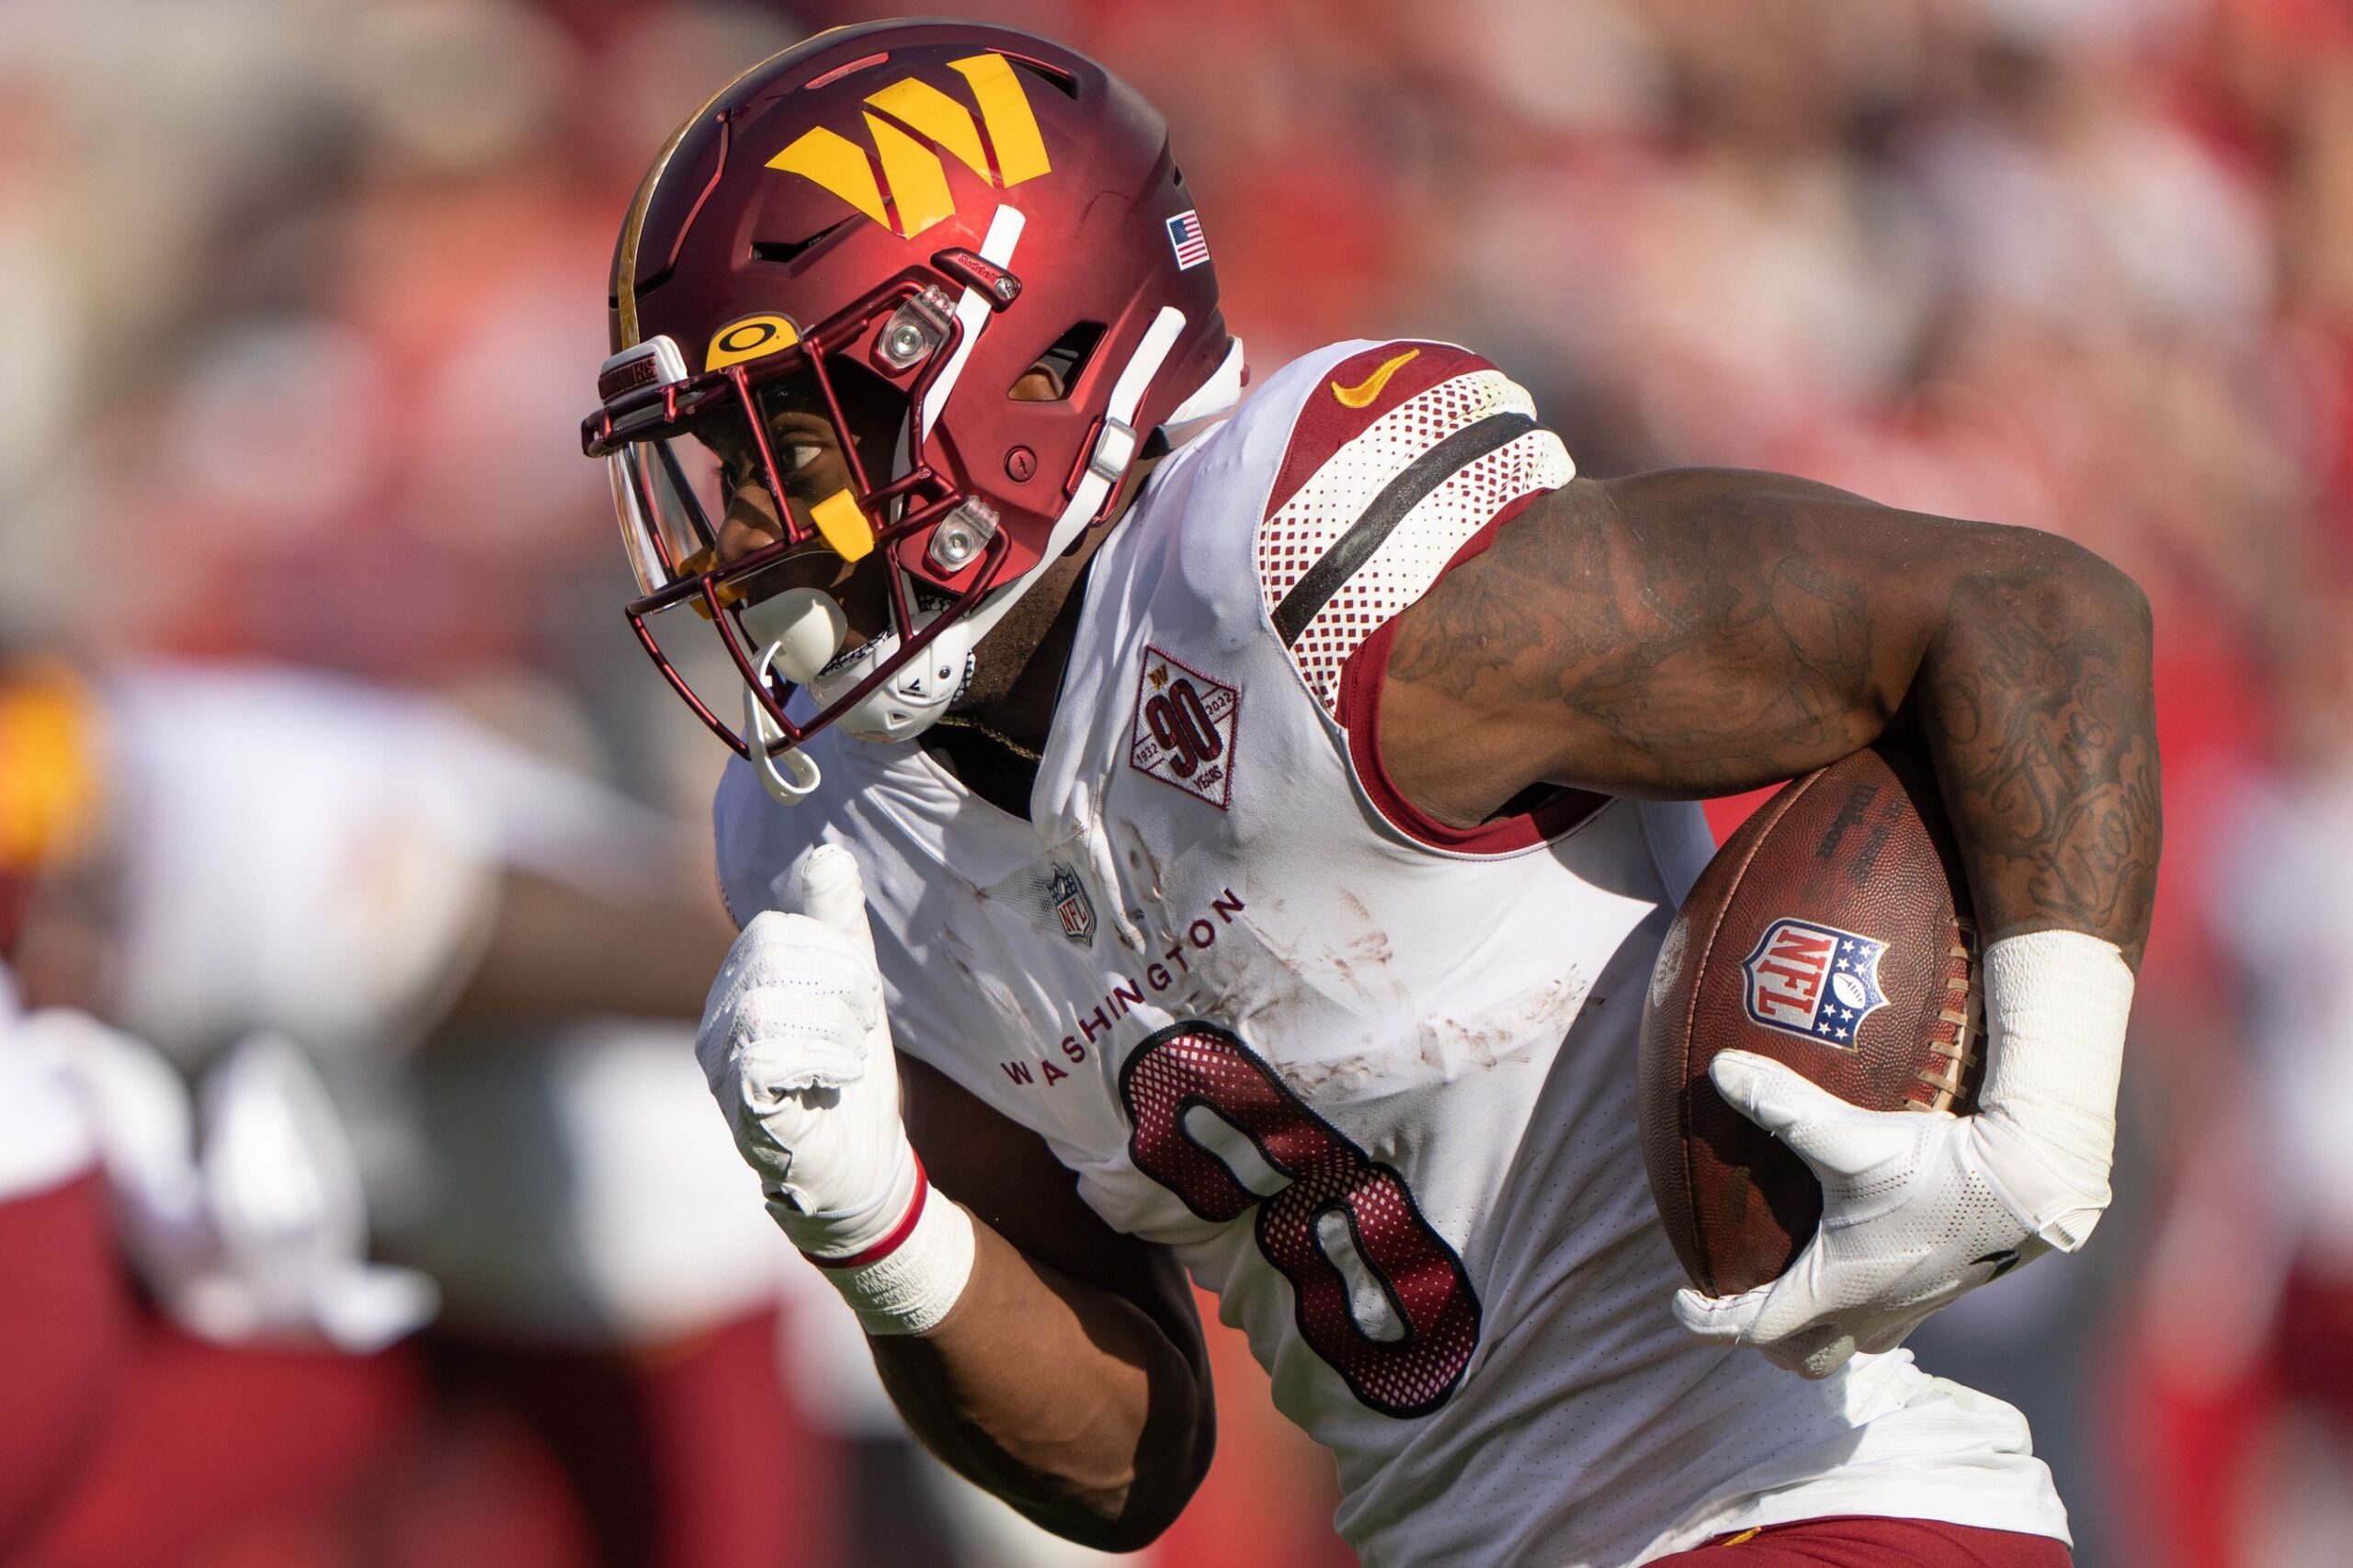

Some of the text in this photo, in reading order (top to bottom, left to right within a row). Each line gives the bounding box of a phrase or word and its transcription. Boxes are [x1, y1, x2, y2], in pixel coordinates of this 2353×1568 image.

[765, 53, 1051, 241] W
[958, 253, 999, 283] Riddell
[1145, 678, 1223, 778] 90
[1206, 692, 1233, 716] 2022
[1136, 743, 1159, 765] 1932
[1194, 765, 1223, 792] YEARS
[1058, 896, 1088, 933] NFL
[1000, 887, 1245, 1087] WASHINGTON
[1756, 929, 1833, 1016] NFL
[1118, 1019, 1483, 1419] 8
